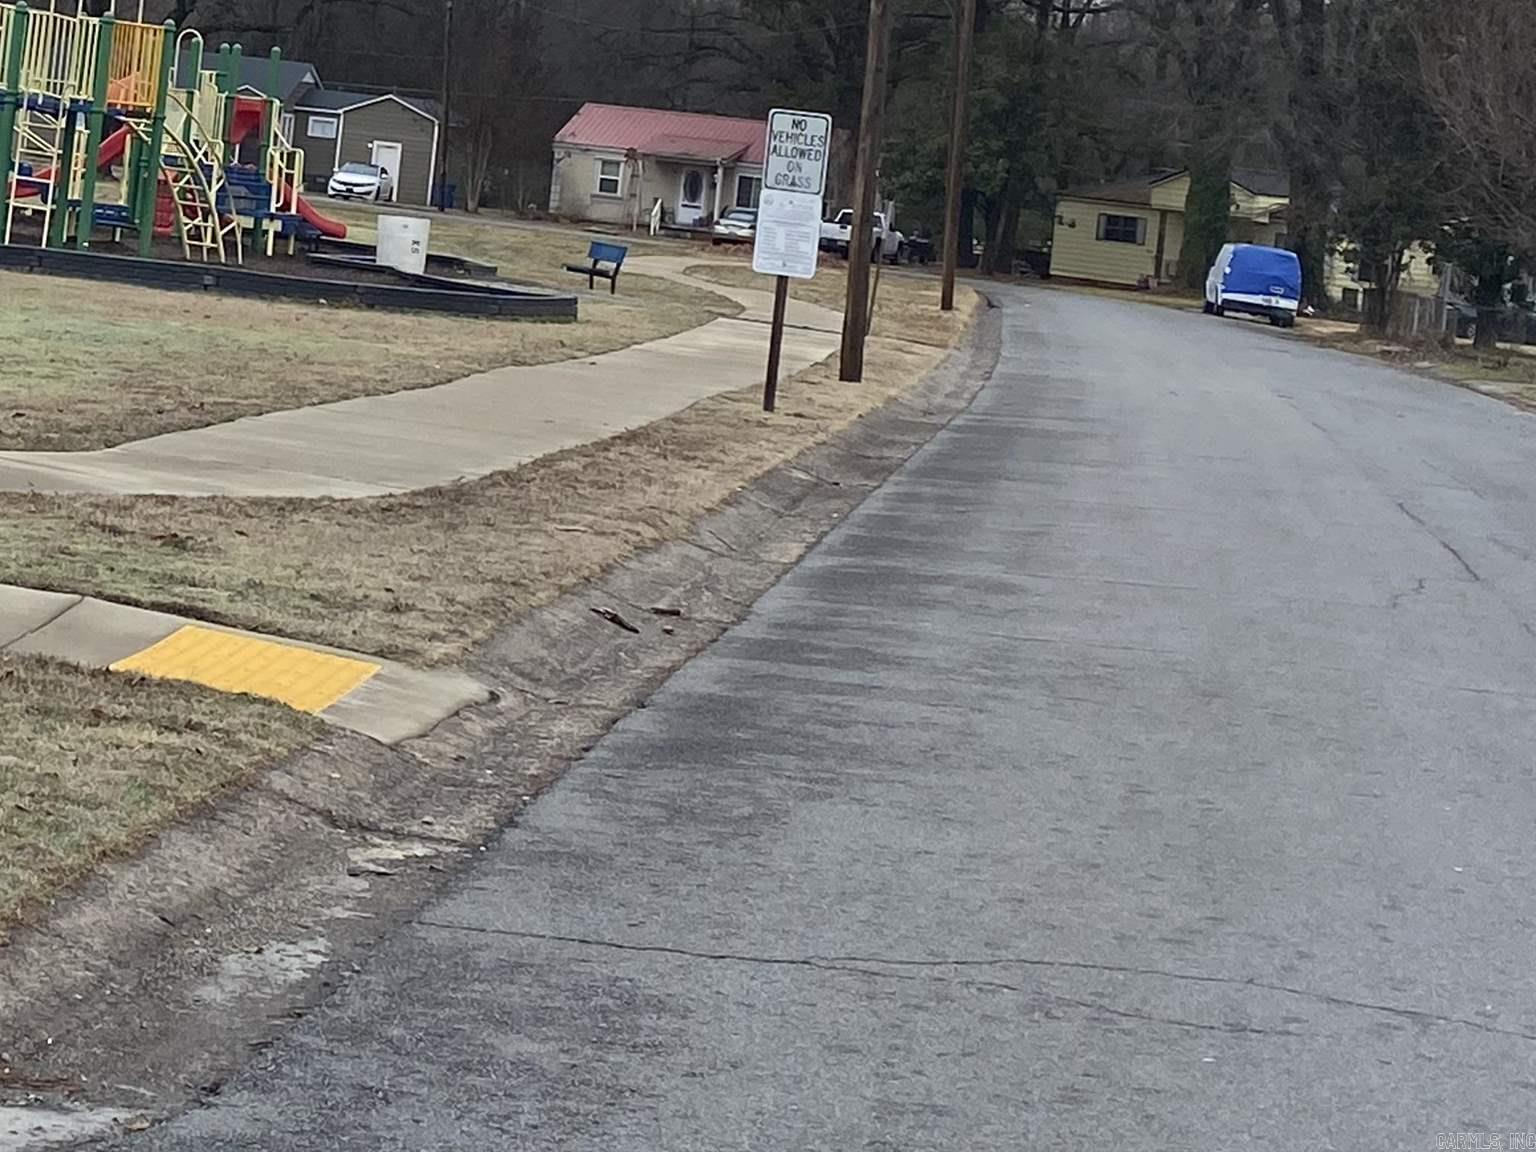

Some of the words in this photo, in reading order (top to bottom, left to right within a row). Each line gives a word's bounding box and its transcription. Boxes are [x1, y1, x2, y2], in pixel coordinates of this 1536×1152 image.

[791, 119, 807, 131] NO
[772, 130, 825, 147] VEHICLES
[770, 144, 822, 161] ALLOWED
[786, 160, 802, 173] ON
[774, 172, 812, 189] GRASS
